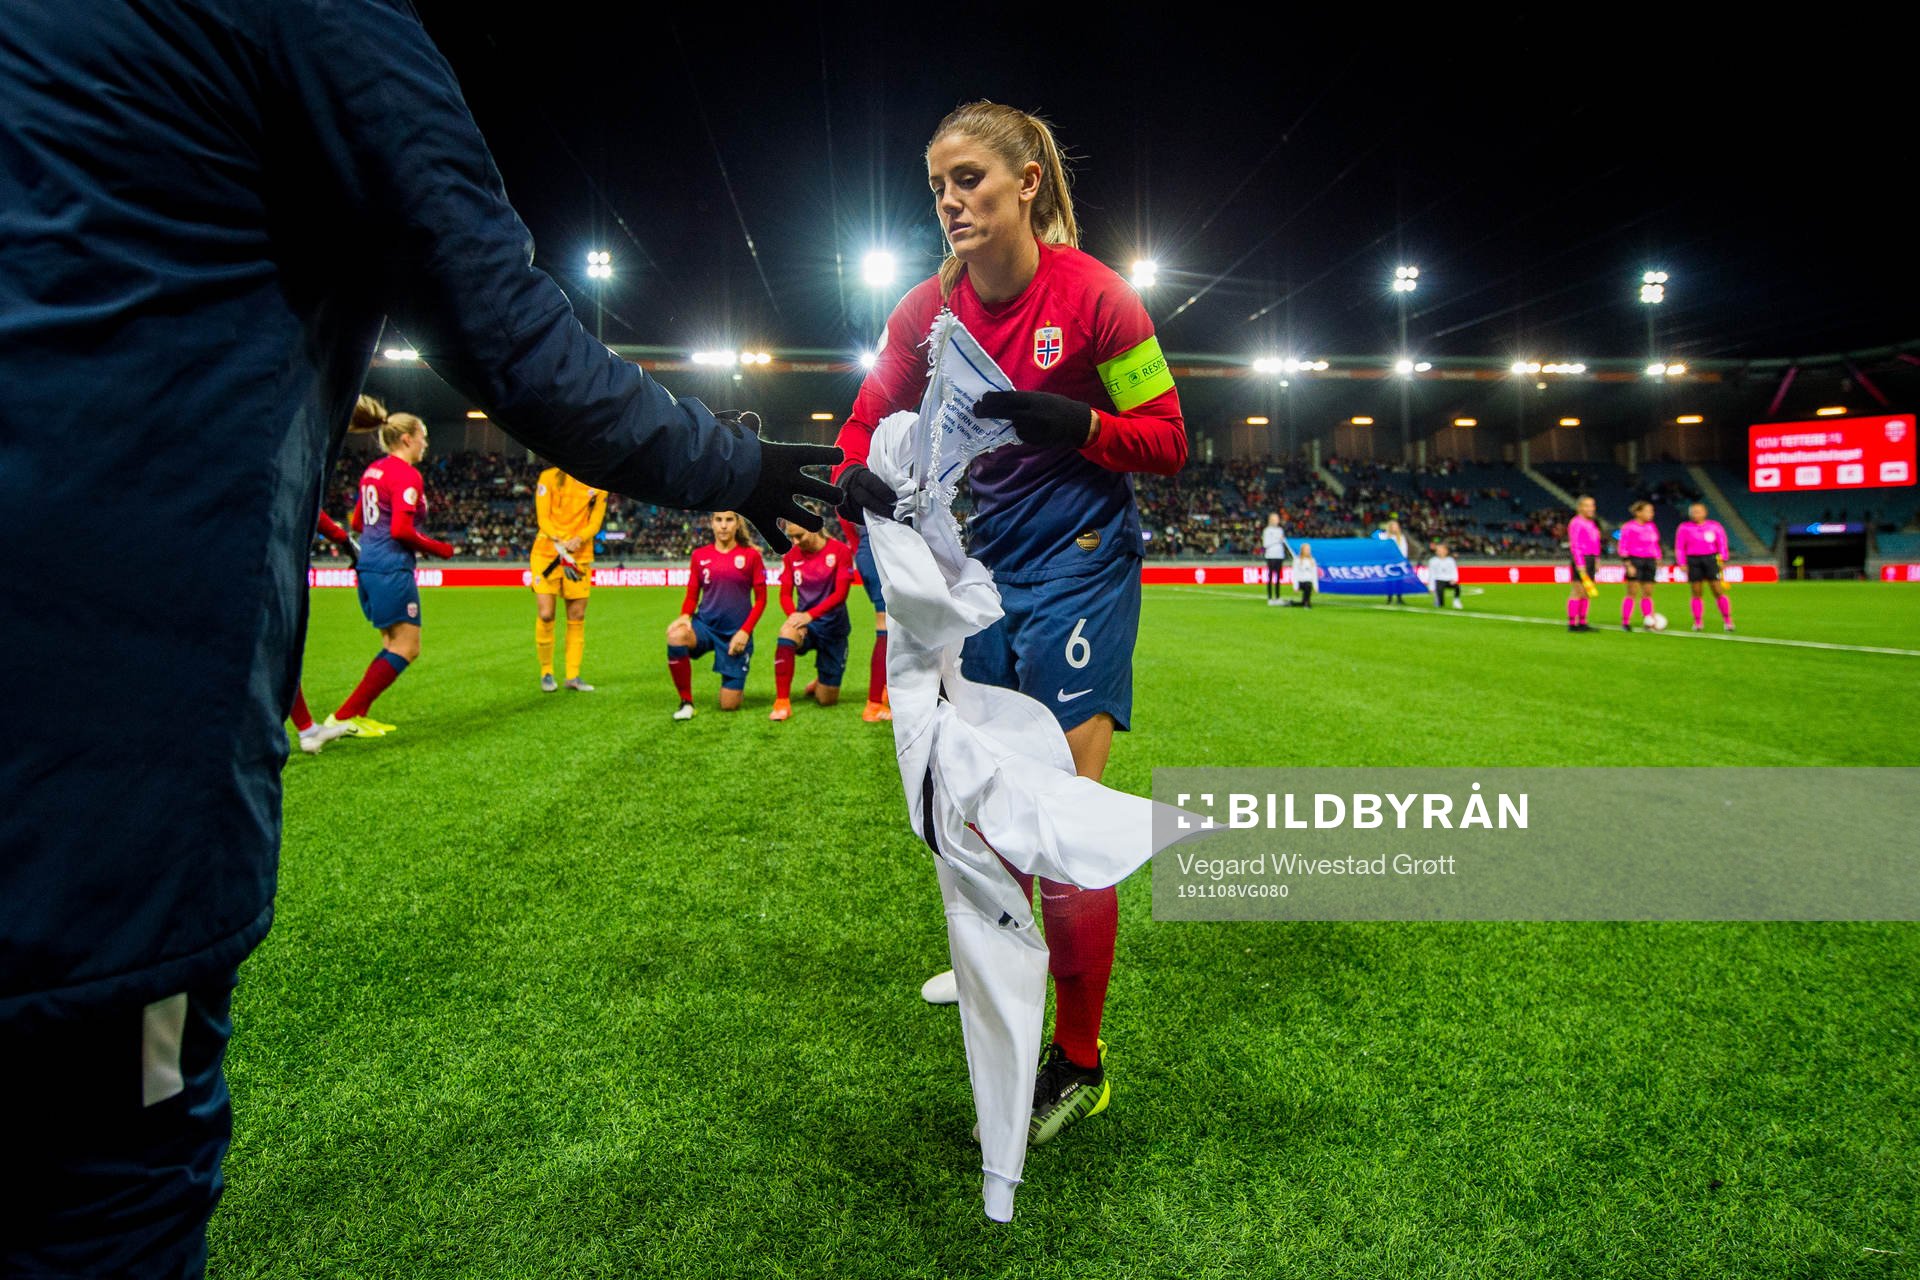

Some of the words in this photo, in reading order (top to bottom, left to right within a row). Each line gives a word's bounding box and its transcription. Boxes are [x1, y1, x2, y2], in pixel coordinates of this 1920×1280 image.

[361, 484, 380, 526] 18
[703, 568, 711, 585] 2
[794, 569, 802, 586] 8
[1328, 562, 1409, 580] RESPECT
[1065, 618, 1091, 669] 6
